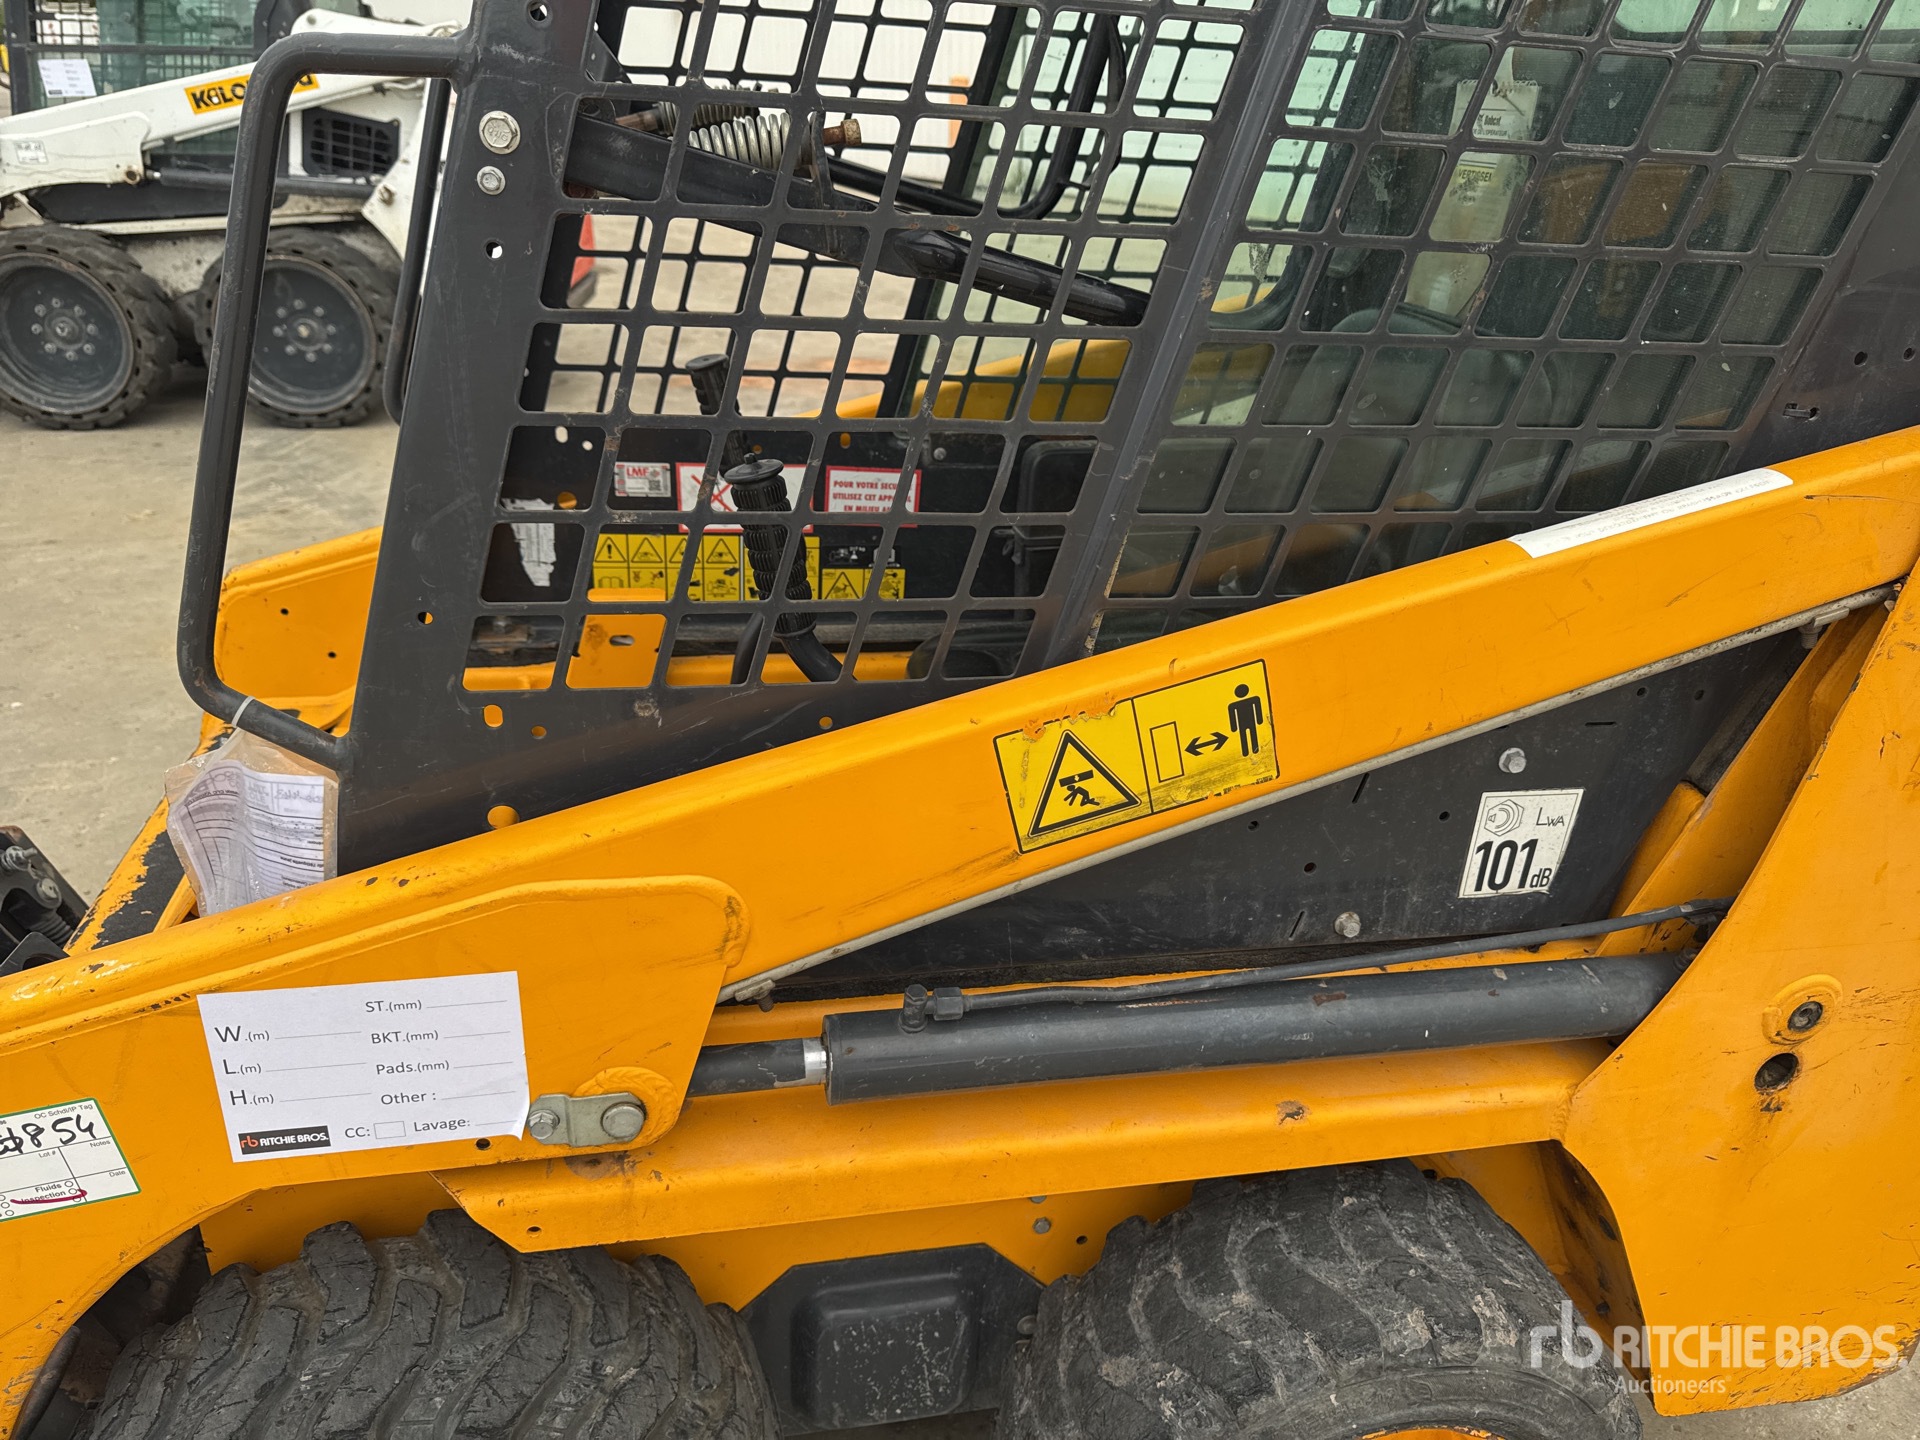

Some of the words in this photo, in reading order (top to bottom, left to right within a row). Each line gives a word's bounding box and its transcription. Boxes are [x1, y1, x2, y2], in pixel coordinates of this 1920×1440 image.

[833, 480, 854, 489] POUR
[857, 481, 879, 490] VOTRE
[832, 492, 862, 500] UTILISEZ
[864, 493, 876, 501] CET
[1474, 838, 1538, 892] 101
[1529, 868, 1552, 888] dB
[365, 1000, 422, 1013] ST.(mm)
[371, 1030, 439, 1044] BKT.(mm)
[376, 1060, 450, 1075] Pads.(mm)
[380, 1092, 427, 1105] Other
[79, 1103, 93, 1111] Tag
[413, 1119, 471, 1132] Lavage:
[344, 1126, 371, 1138] CC:
[89, 1139, 111, 1148] Notes
[260, 1135, 296, 1147] RITCHIE
[297, 1132, 329, 1143] BROS.
[108, 1170, 126, 1178] Date
[35, 1182, 62, 1193] Fluids
